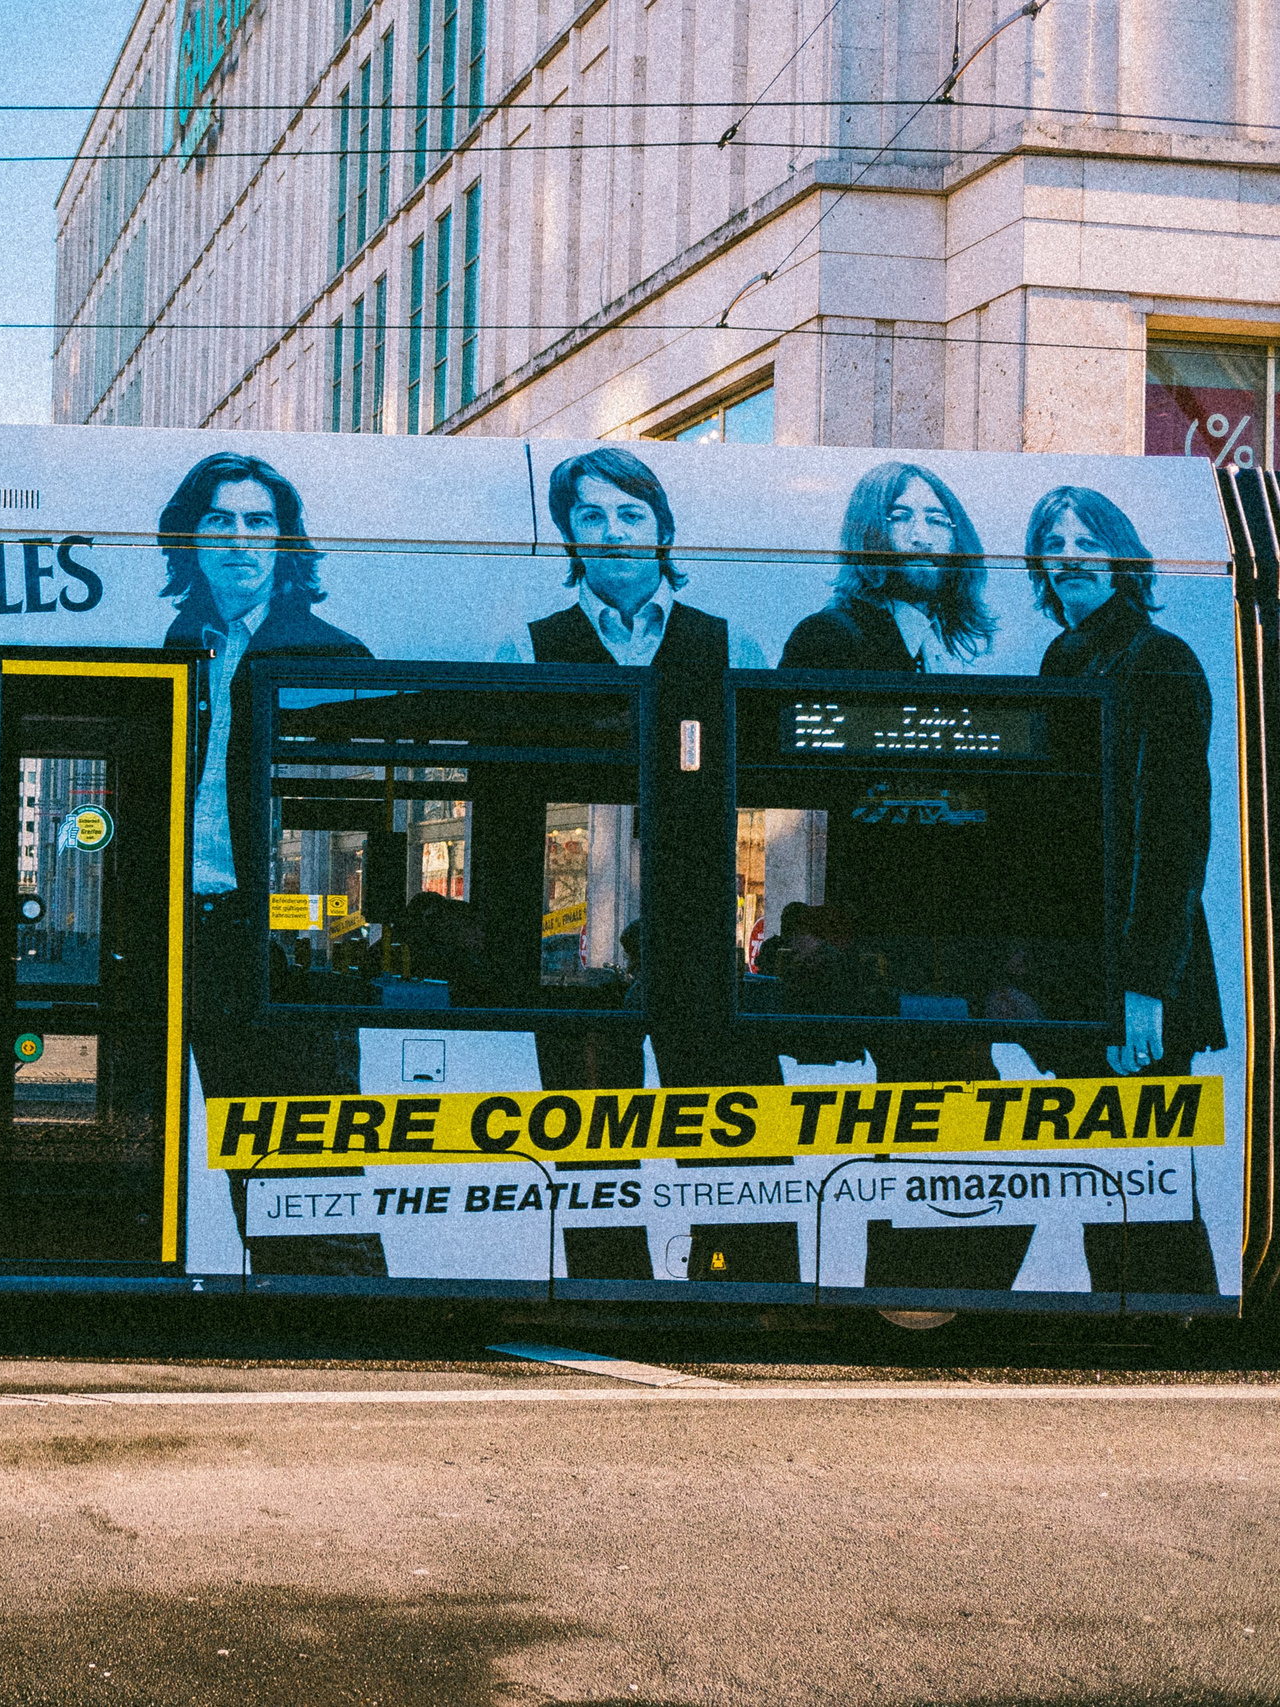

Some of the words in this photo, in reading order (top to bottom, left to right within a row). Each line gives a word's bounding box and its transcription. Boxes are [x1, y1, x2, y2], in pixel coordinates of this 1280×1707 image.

[219, 1100, 438, 1157] HERE
[470, 1091, 758, 1152] COMES
[790, 1086, 946, 1146] THE
[975, 1083, 1203, 1140] TRAM
[267, 1193, 362, 1219] JETZT
[373, 1187, 453, 1216] THE
[464, 1180, 642, 1213] BEATLES
[653, 1176, 822, 1208] STREAMEN
[831, 1177, 896, 1202] AUF
[906, 1172, 1049, 1209] amazon
[1060, 1160, 1177, 1196] music
